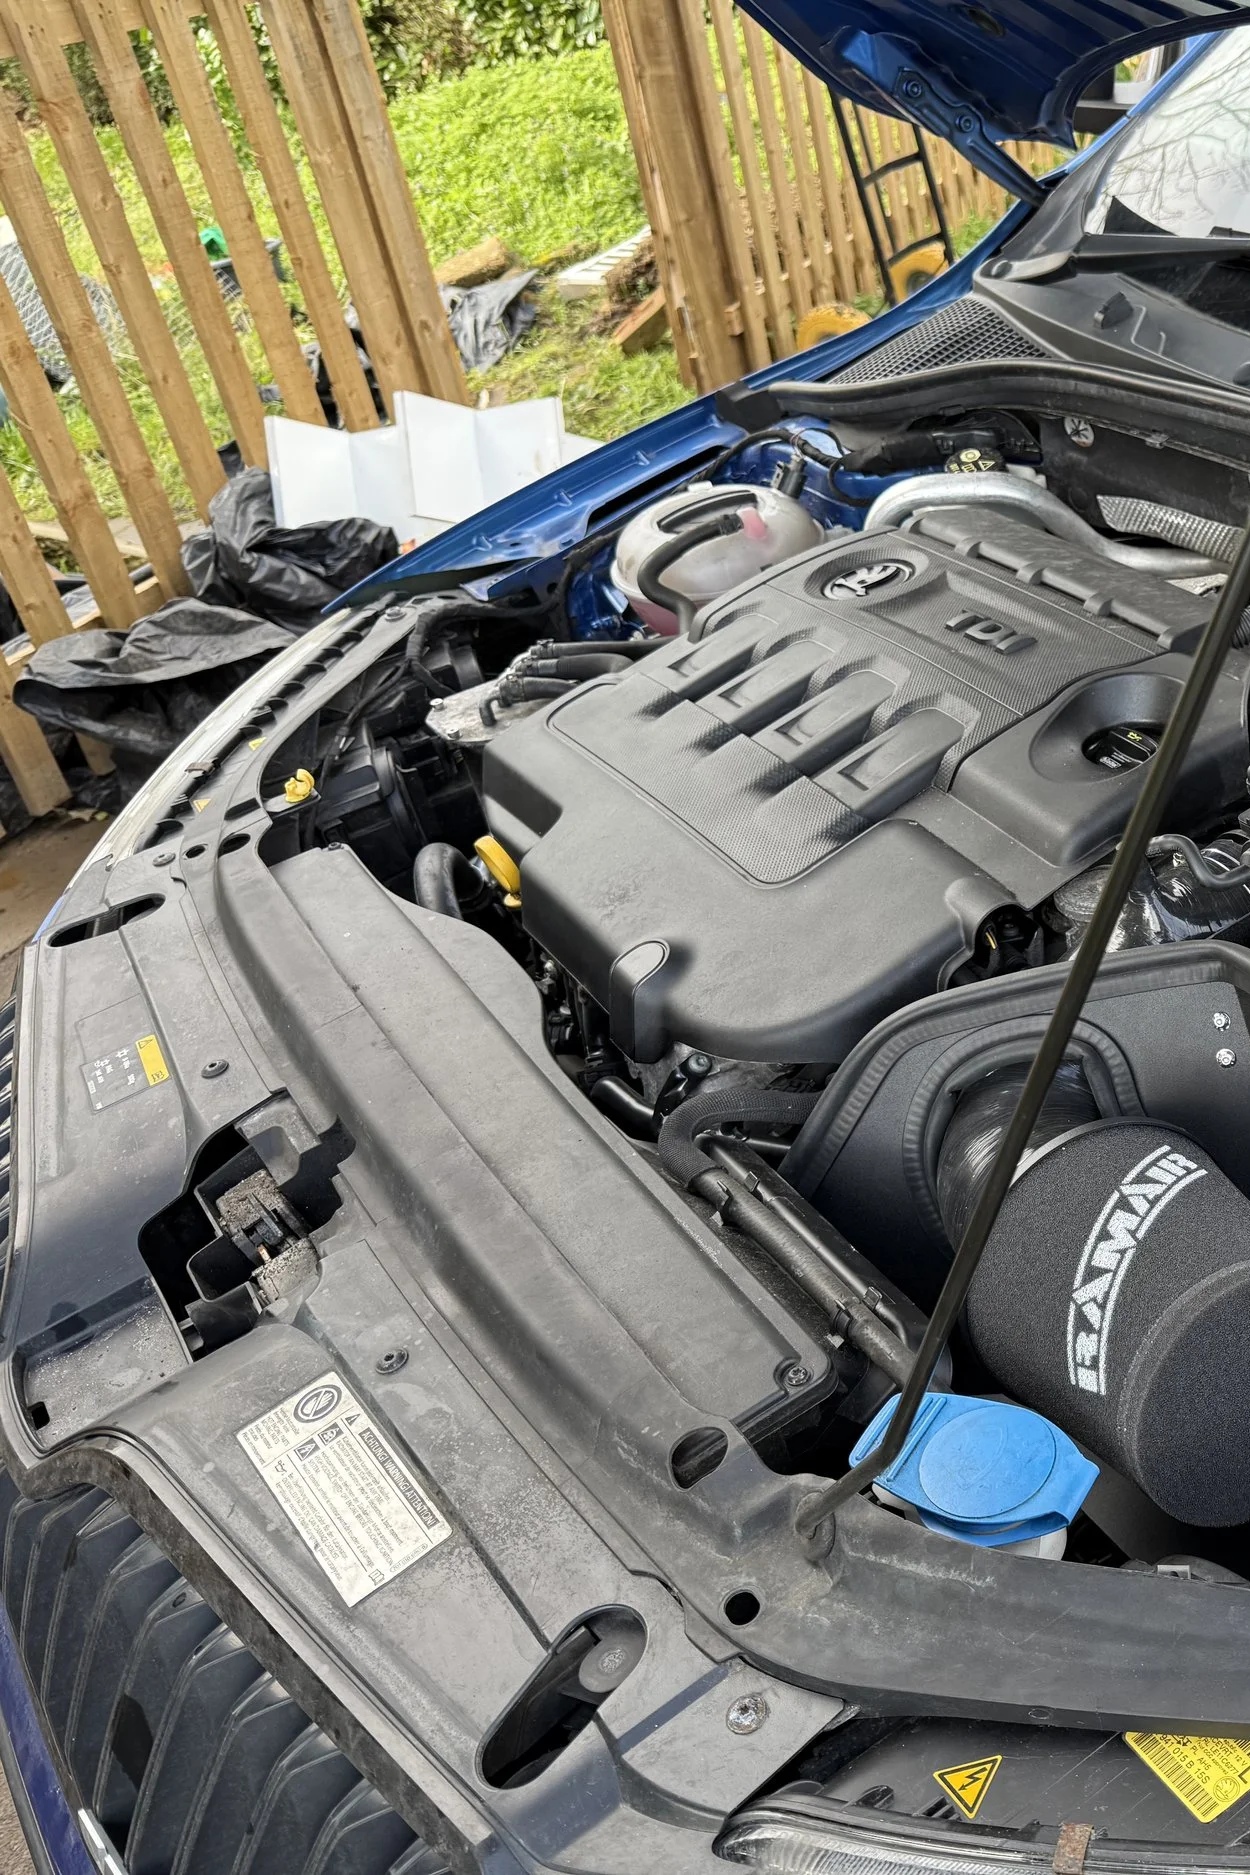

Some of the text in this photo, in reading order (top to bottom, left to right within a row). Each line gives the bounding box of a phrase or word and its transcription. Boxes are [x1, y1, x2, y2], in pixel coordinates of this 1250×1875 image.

[944, 608, 1037, 655] TDI
[1073, 1150, 1201, 1395] RAMAIR
[360, 1429, 389, 1463] ACHTUNG!
[382, 1458, 411, 1492] WARNING!
[403, 1487, 436, 1527] ATTENTION!
[1172, 1747, 1187, 1763] 015
[1185, 1760, 1195, 1769] B
[1194, 1768, 1211, 1785] 15S
